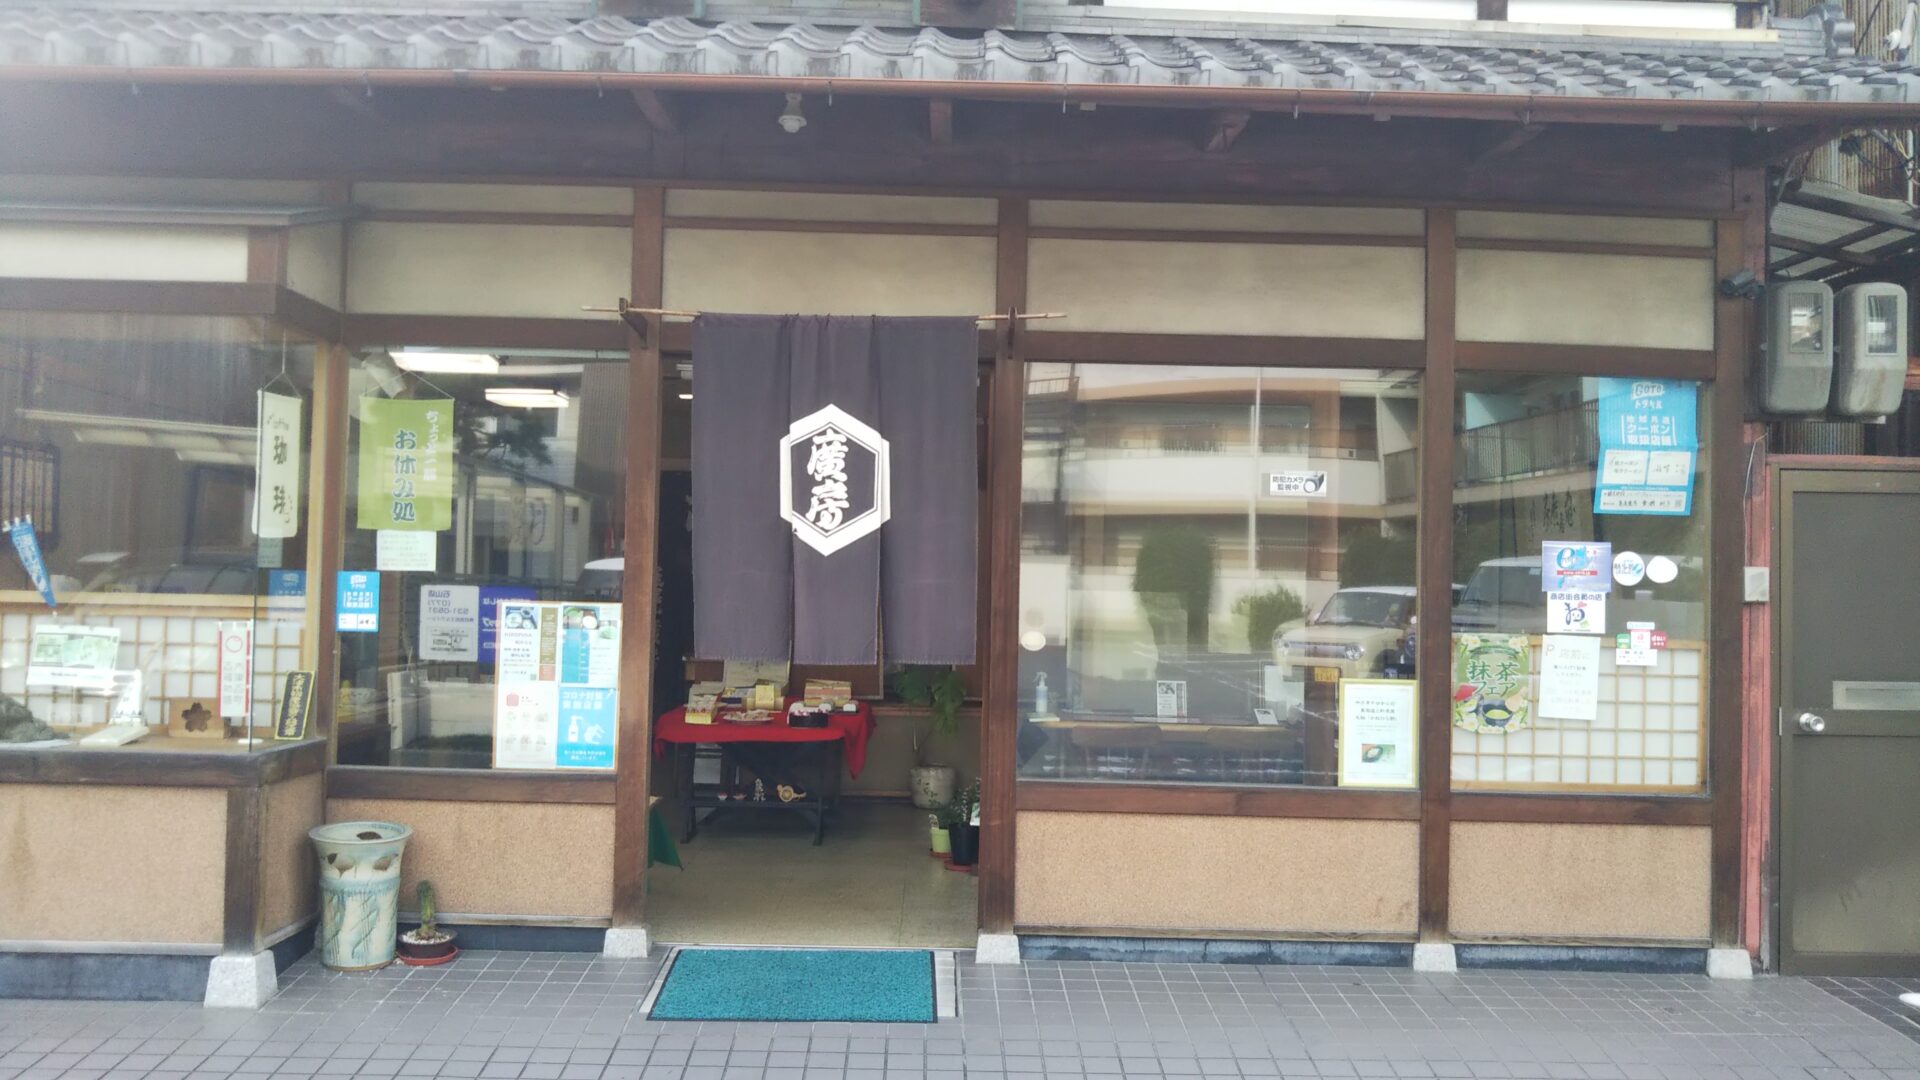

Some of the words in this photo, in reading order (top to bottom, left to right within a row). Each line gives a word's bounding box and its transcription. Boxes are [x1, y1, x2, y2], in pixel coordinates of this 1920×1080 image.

[1626, 424, 1670, 434] クーポン
[393, 428, 417, 522] お休み処
[1468, 661, 1519, 681] 抹茶
[1471, 680, 1516, 698] フェア
